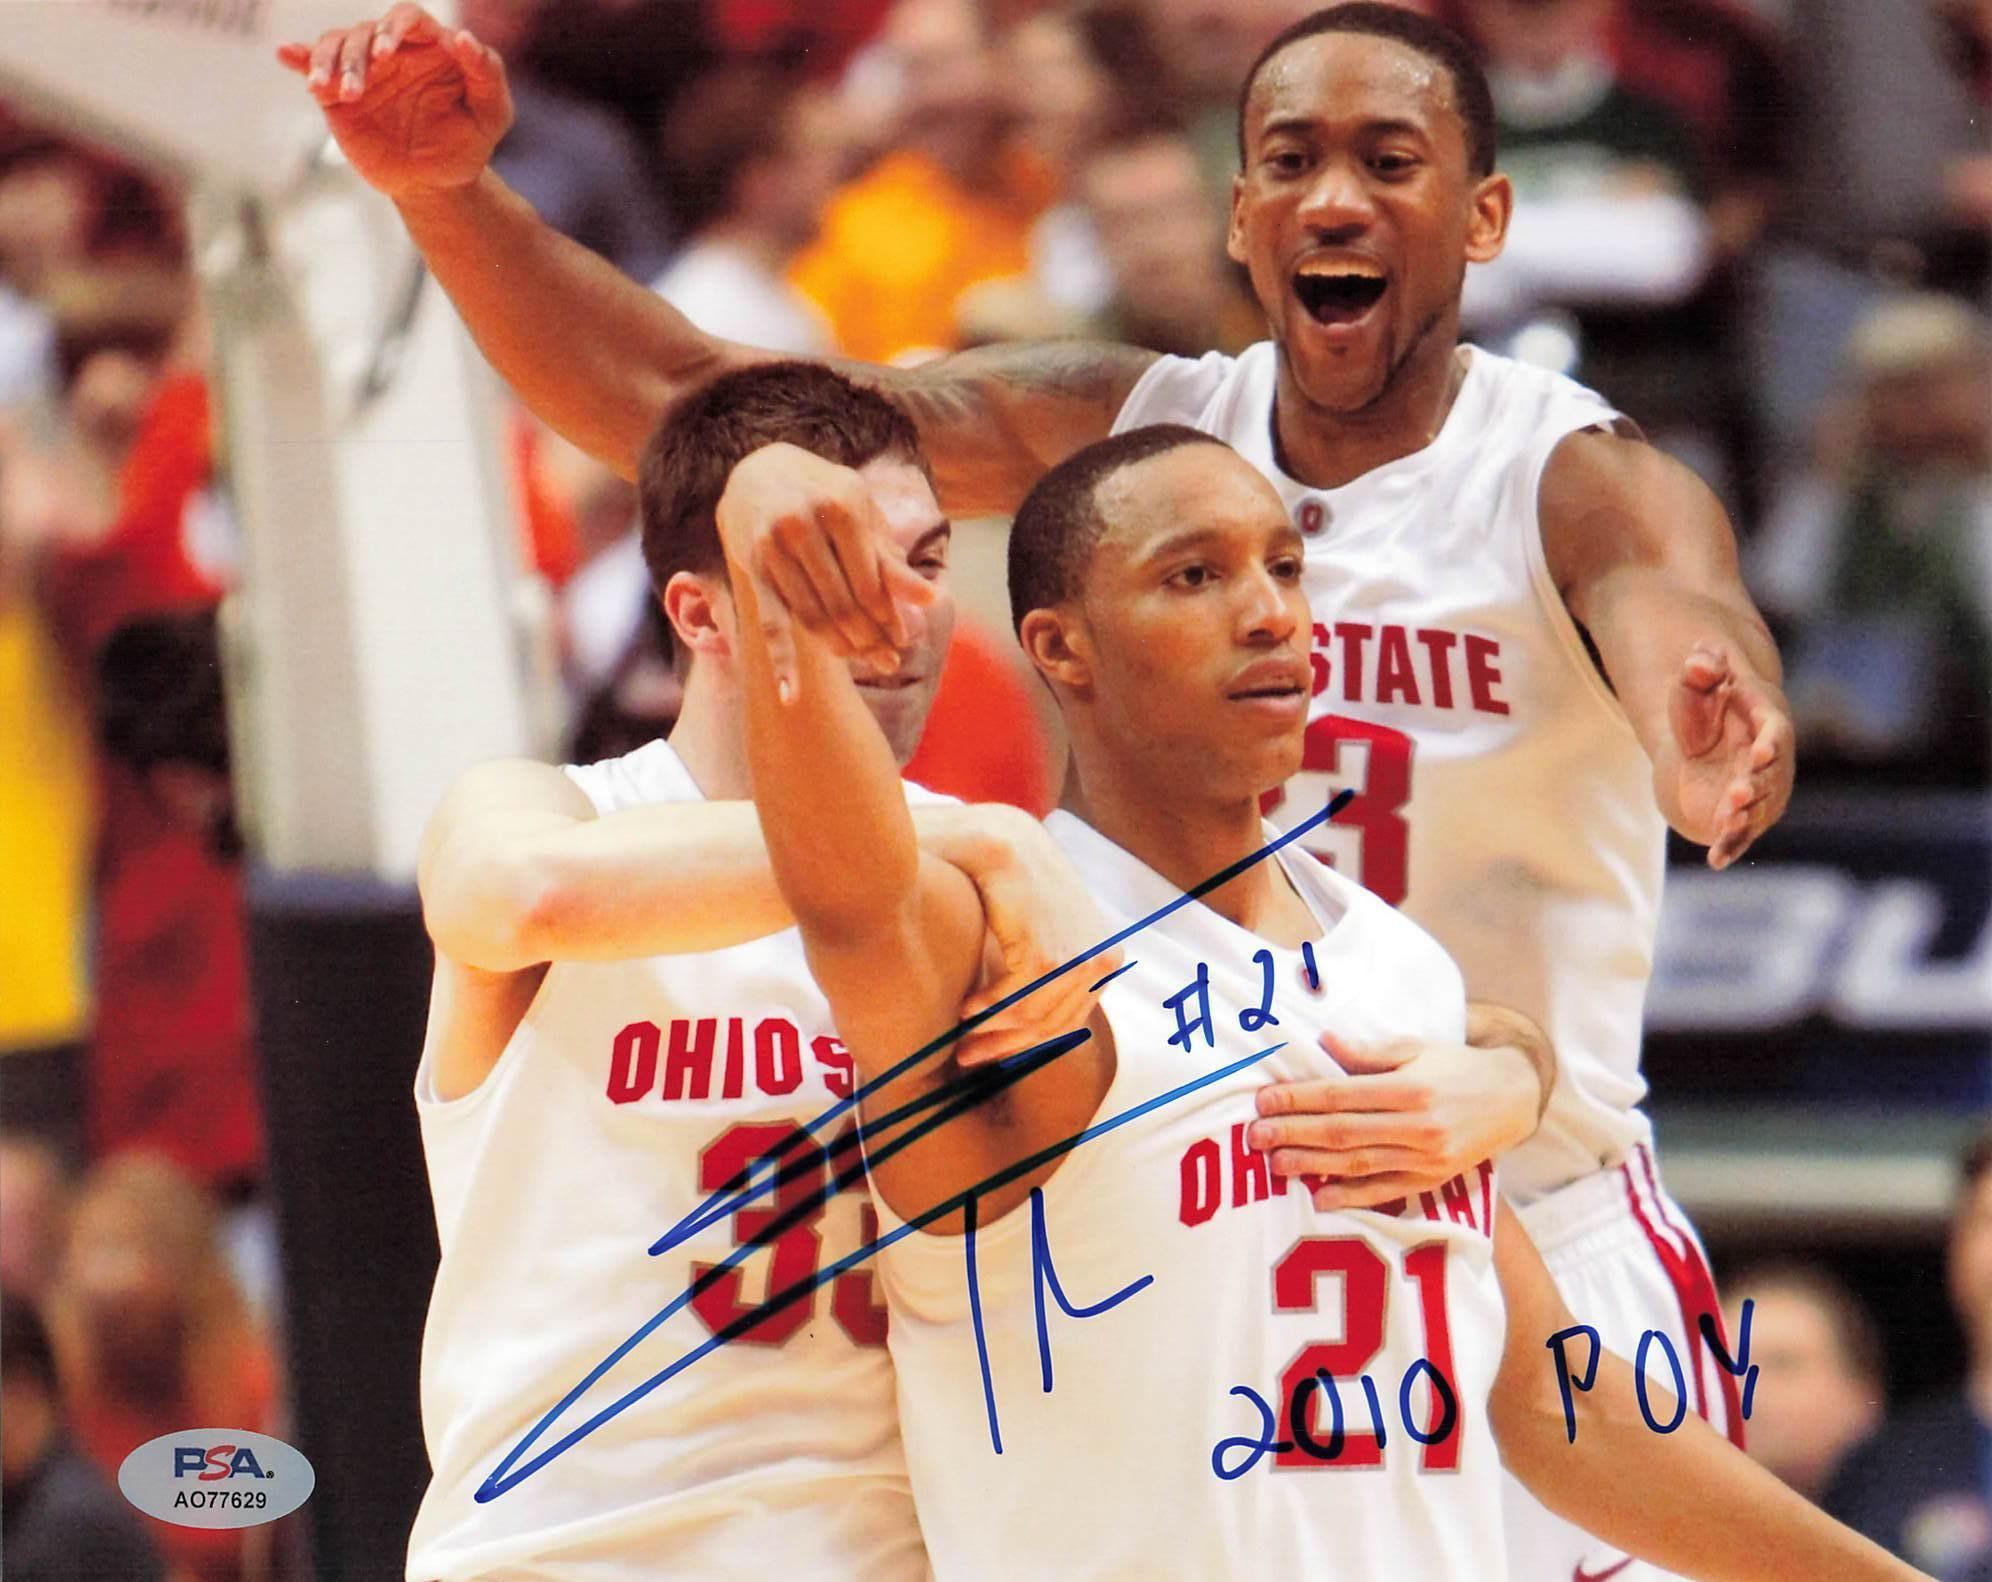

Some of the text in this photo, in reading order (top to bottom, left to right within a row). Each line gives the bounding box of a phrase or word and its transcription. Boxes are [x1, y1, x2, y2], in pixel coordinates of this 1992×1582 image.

[1309, 622, 1510, 716] STATE
[1162, 941, 1321, 1054] #21
[606, 1016, 804, 1105] OHIO
[1211, 1298, 1760, 1481] 2010 POY
[1270, 1234, 1464, 1475] 21
